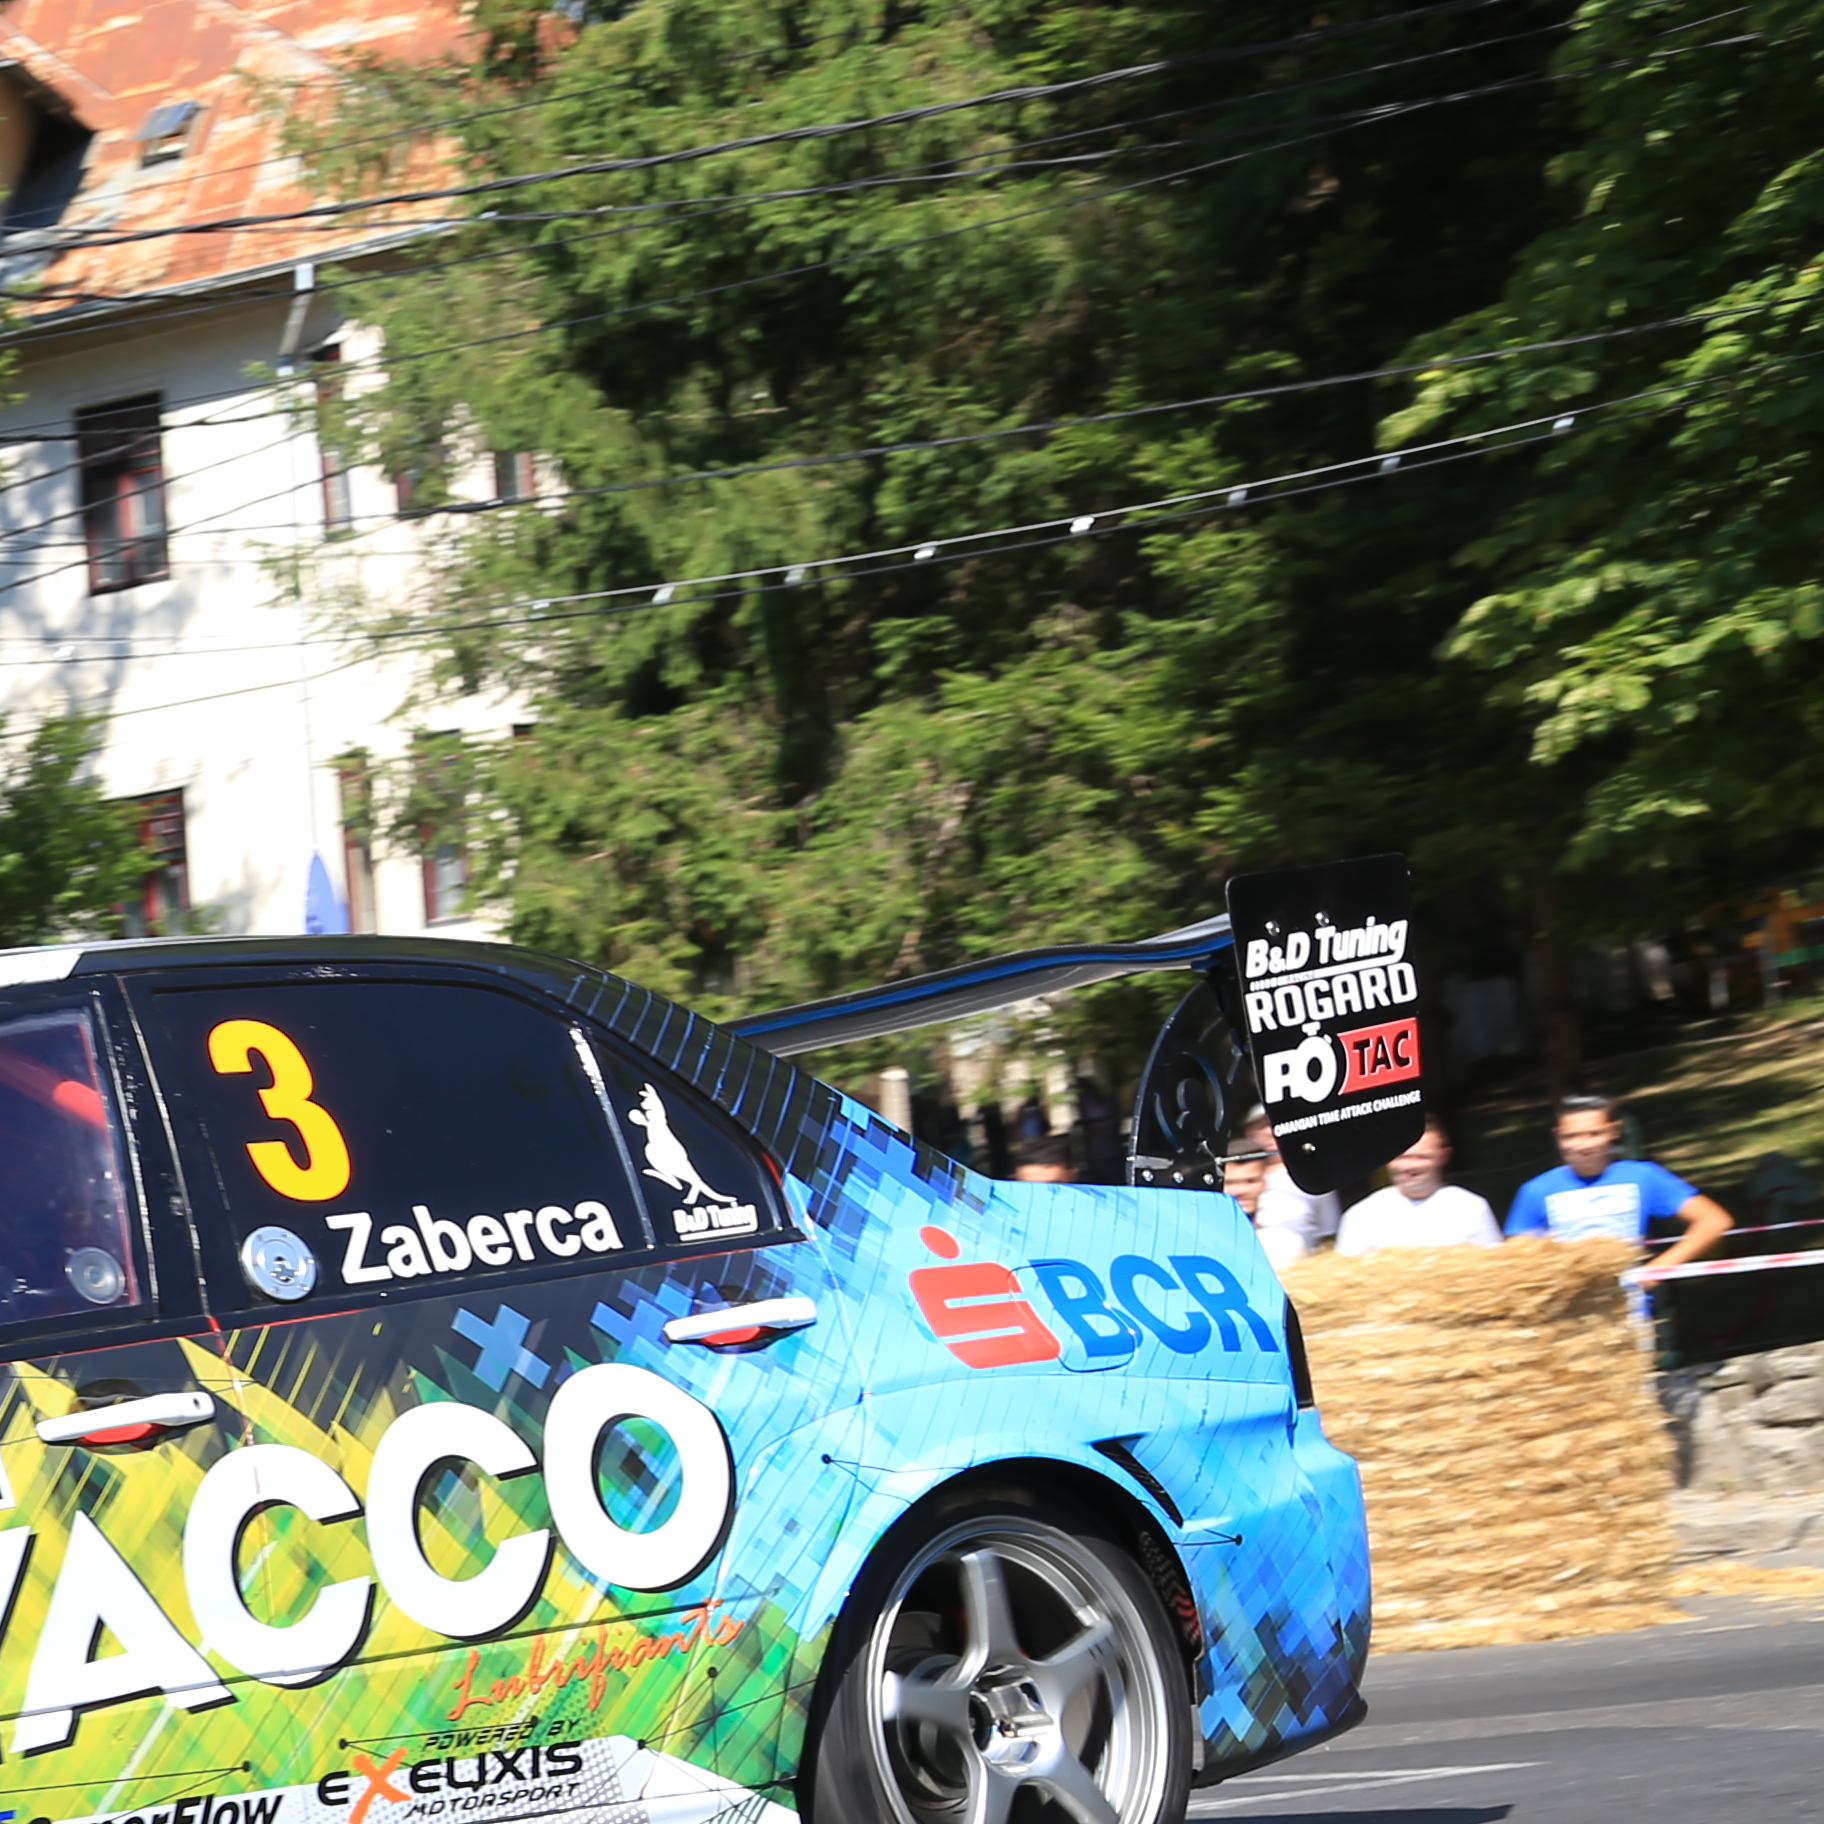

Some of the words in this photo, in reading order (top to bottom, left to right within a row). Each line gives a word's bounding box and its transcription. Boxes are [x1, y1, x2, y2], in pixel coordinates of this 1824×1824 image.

[1245, 932, 1311, 979] B&D
[1315, 915, 1409, 966] Tuning
[1244, 961, 1419, 1034] ROGARD
[1353, 1029, 1413, 1078] TAC
[207, 1018, 352, 1201] 3
[1318, 1109, 1340, 1126] TIME
[1340, 1101, 1373, 1120] ATTACK
[1373, 1089, 1421, 1112] CHALLENGE
[324, 1200, 624, 1285] Zaberca
[1028, 1254, 1280, 1357] BCR
[446, 1597, 746, 1721] Lubrifiants
[423, 1723, 536, 1752] POWERED
[545, 1716, 585, 1738] BY
[403, 1781, 583, 1819] MOTORSPORT
